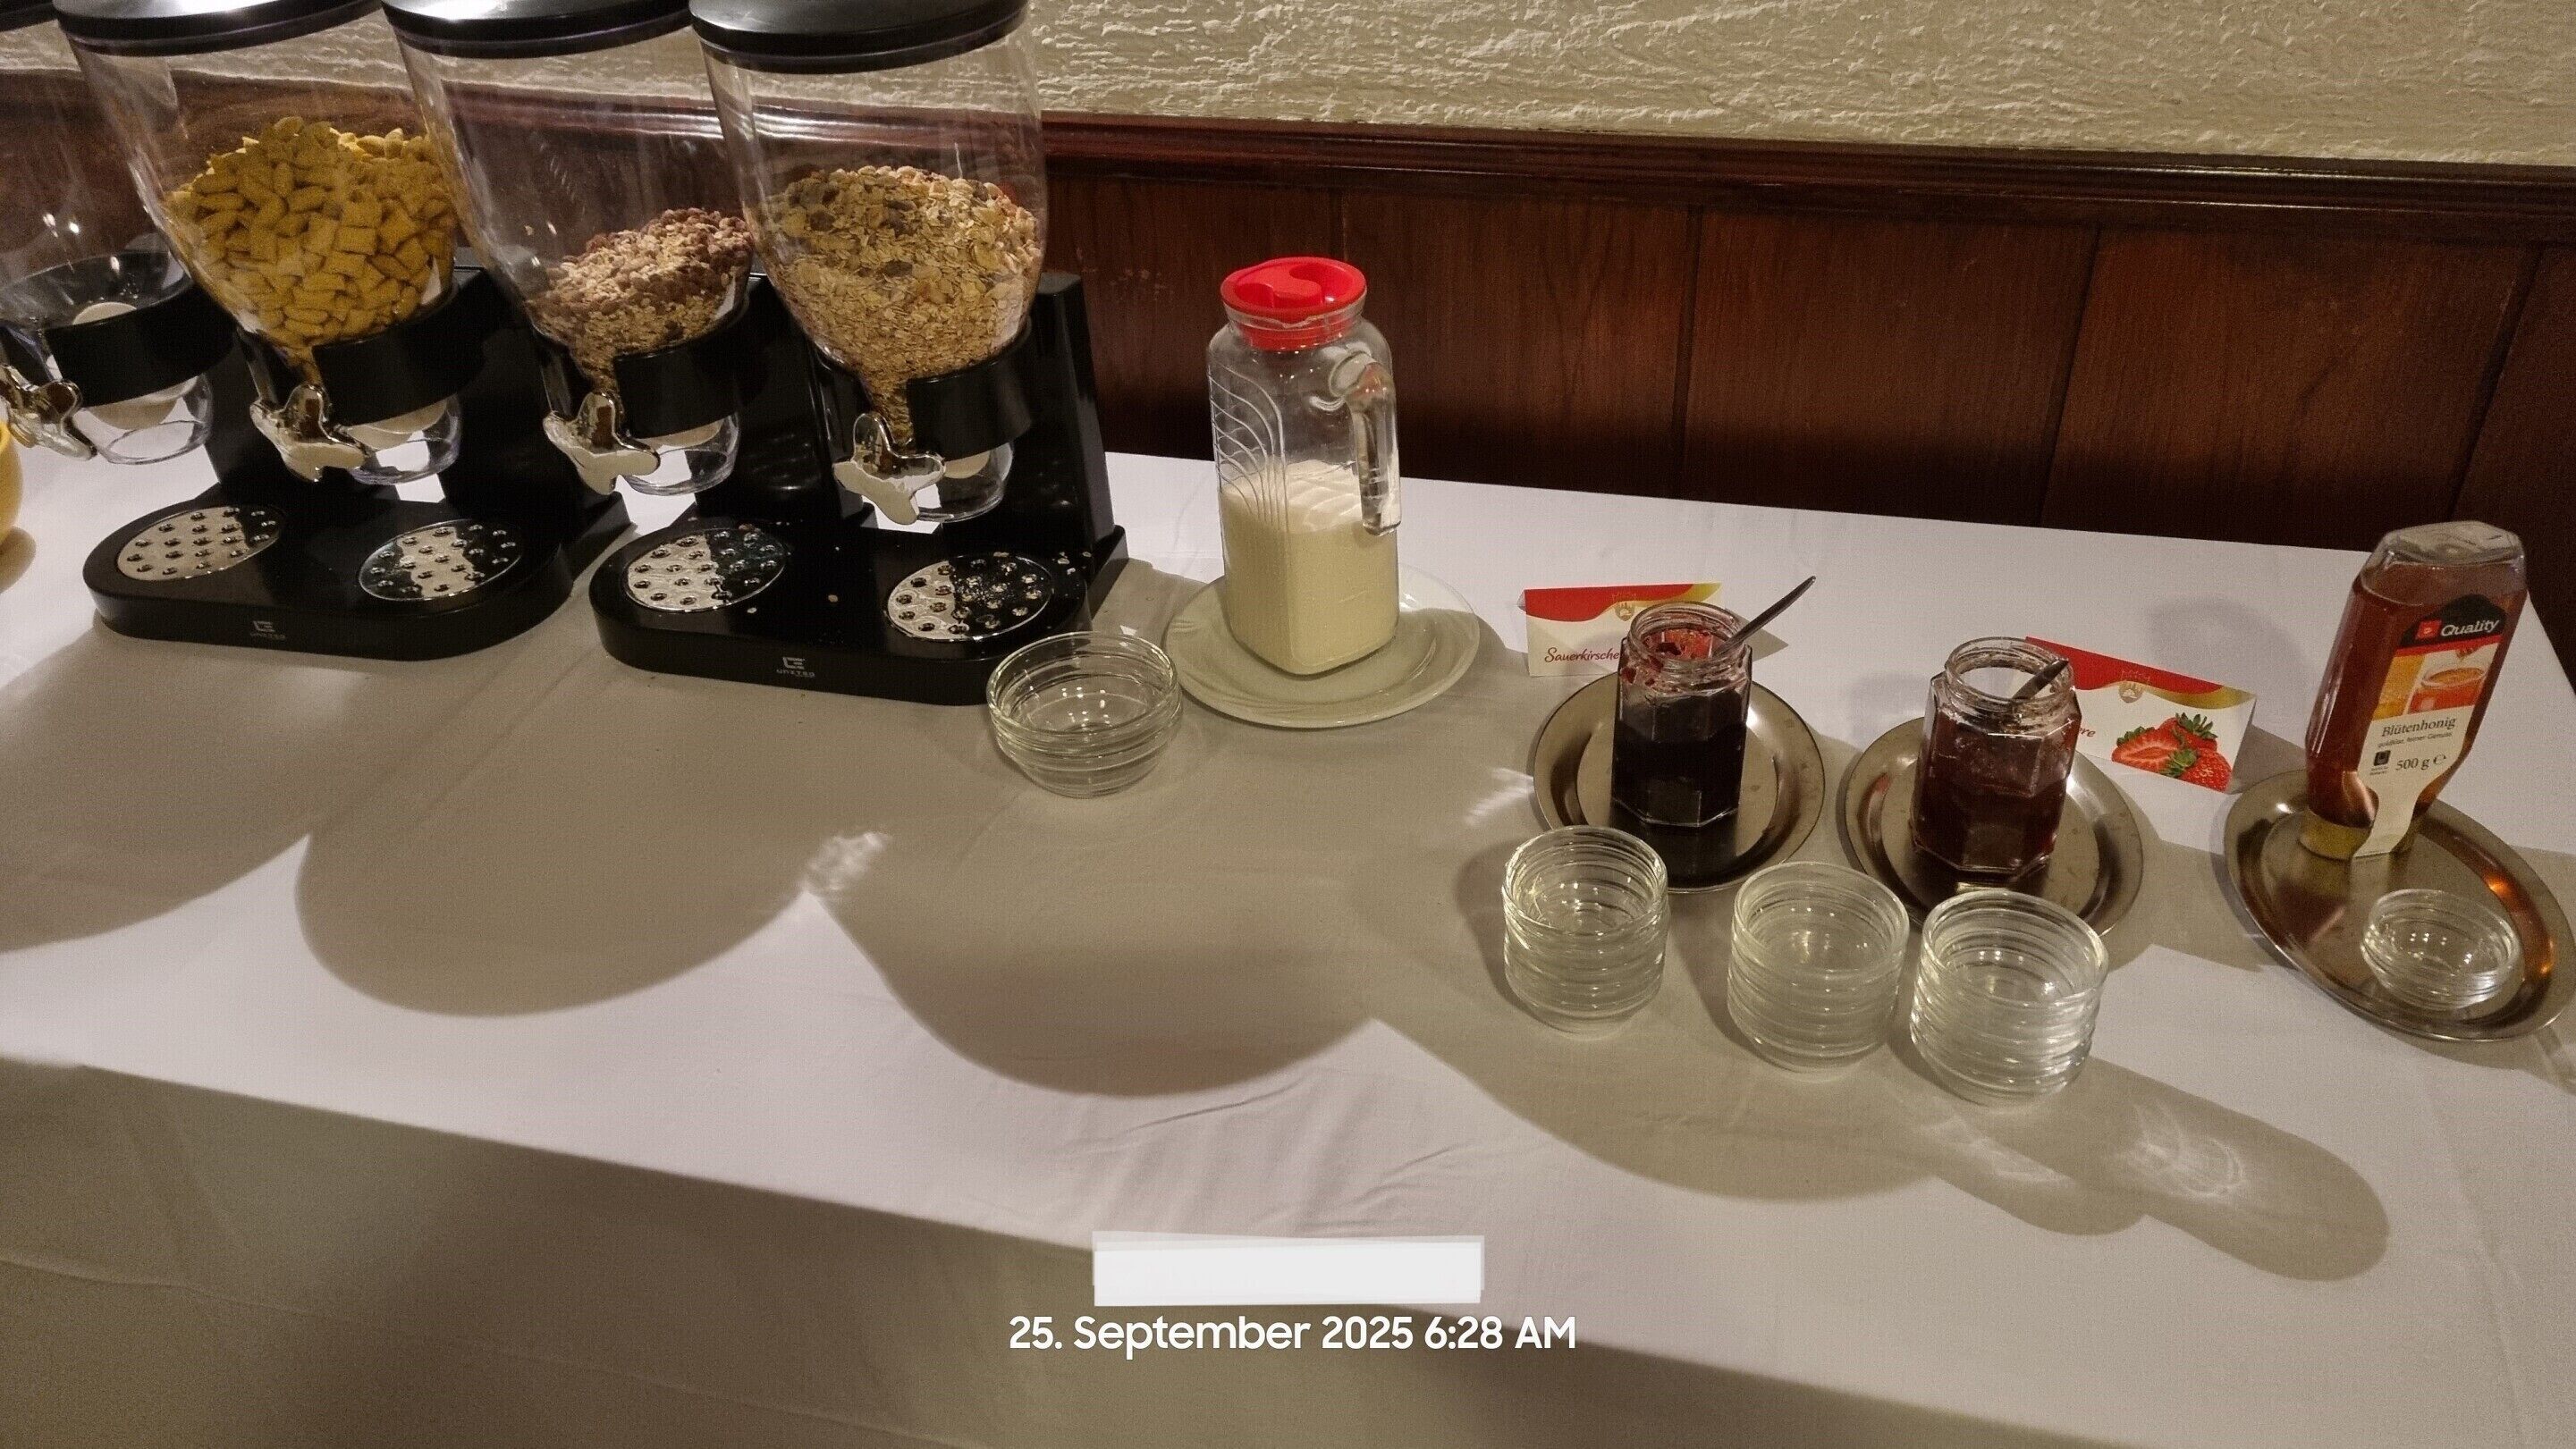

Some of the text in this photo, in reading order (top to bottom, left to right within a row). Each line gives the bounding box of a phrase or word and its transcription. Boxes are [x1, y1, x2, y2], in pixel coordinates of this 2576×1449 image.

[2440, 619, 2500, 636] Quality
[1544, 646, 1620, 663] Sauerkirsche
[2381, 717, 2456, 737] Blütenhonig
[2394, 757, 2420, 771] 500
[2420, 757, 2431, 771] g
